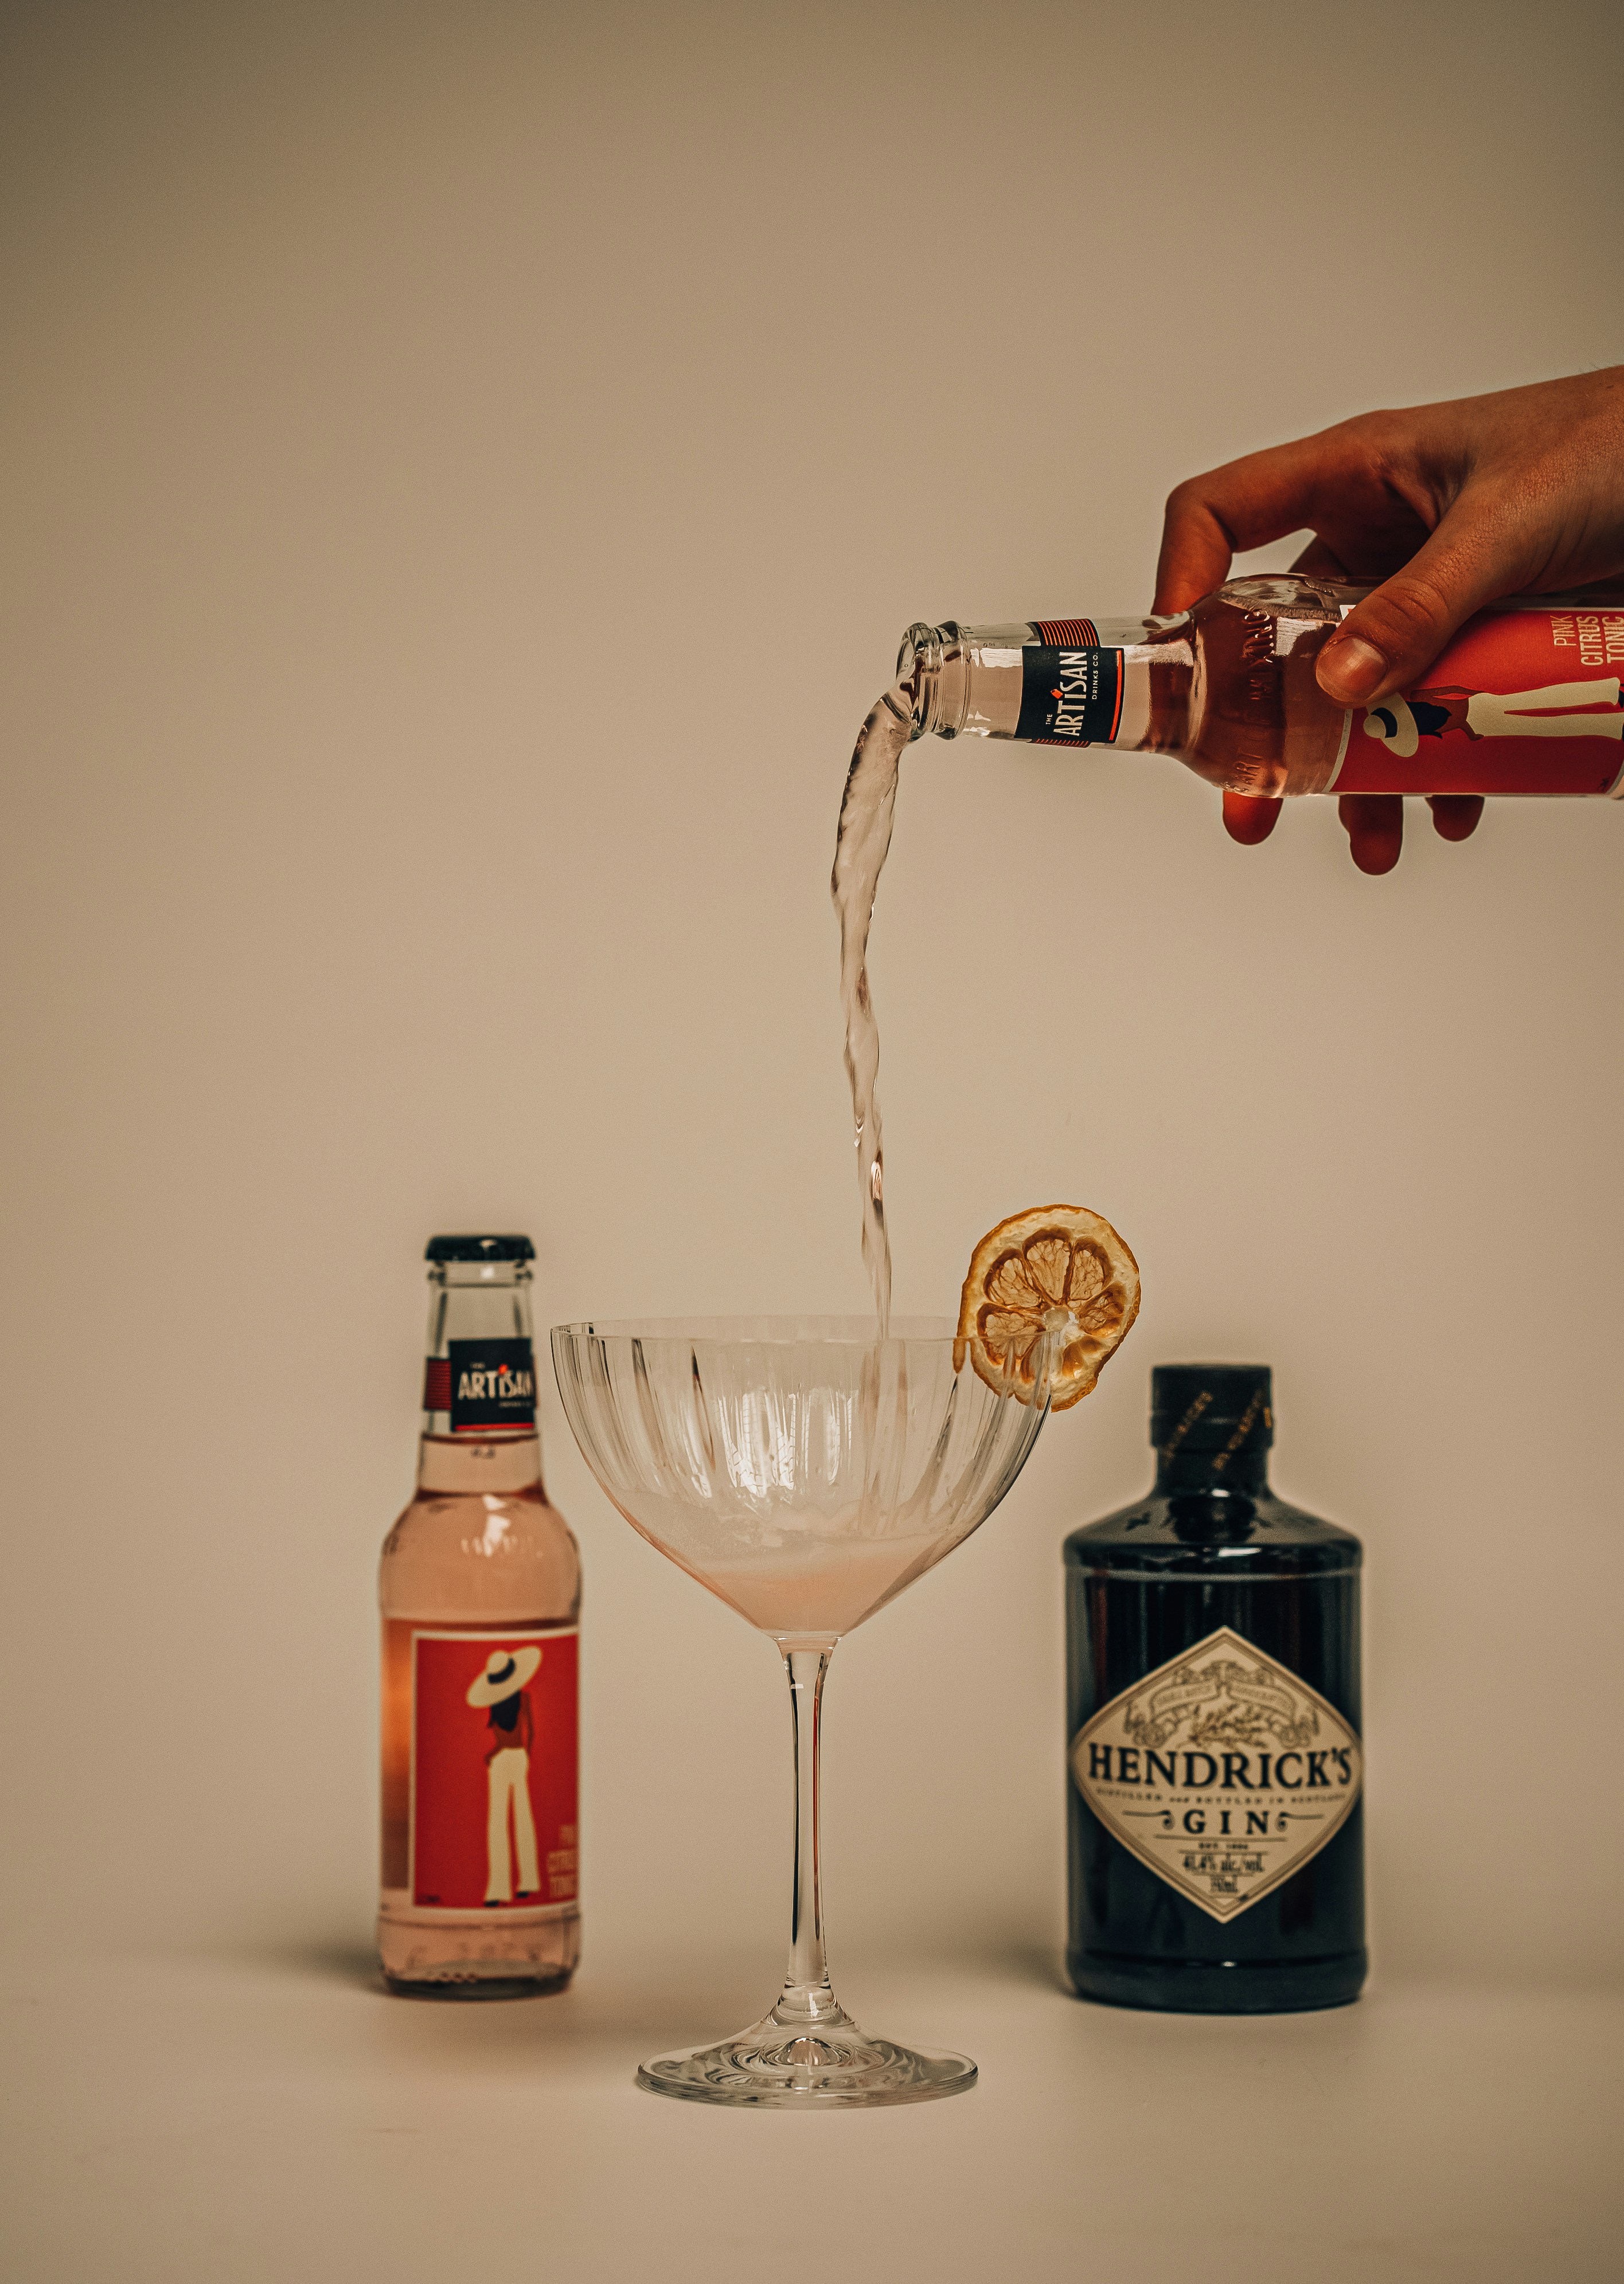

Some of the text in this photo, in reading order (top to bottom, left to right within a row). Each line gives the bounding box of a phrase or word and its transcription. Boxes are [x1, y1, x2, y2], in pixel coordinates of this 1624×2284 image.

[1550, 615, 1577, 646] PINK
[1576, 616, 1603, 666] CITRUS
[1602, 616, 1624, 664] TONIC
[1051, 652, 1087, 736] ARTISAN
[1089, 1742, 1352, 1790] HENDRICK'S
[1182, 1809, 1270, 1836] GIN
